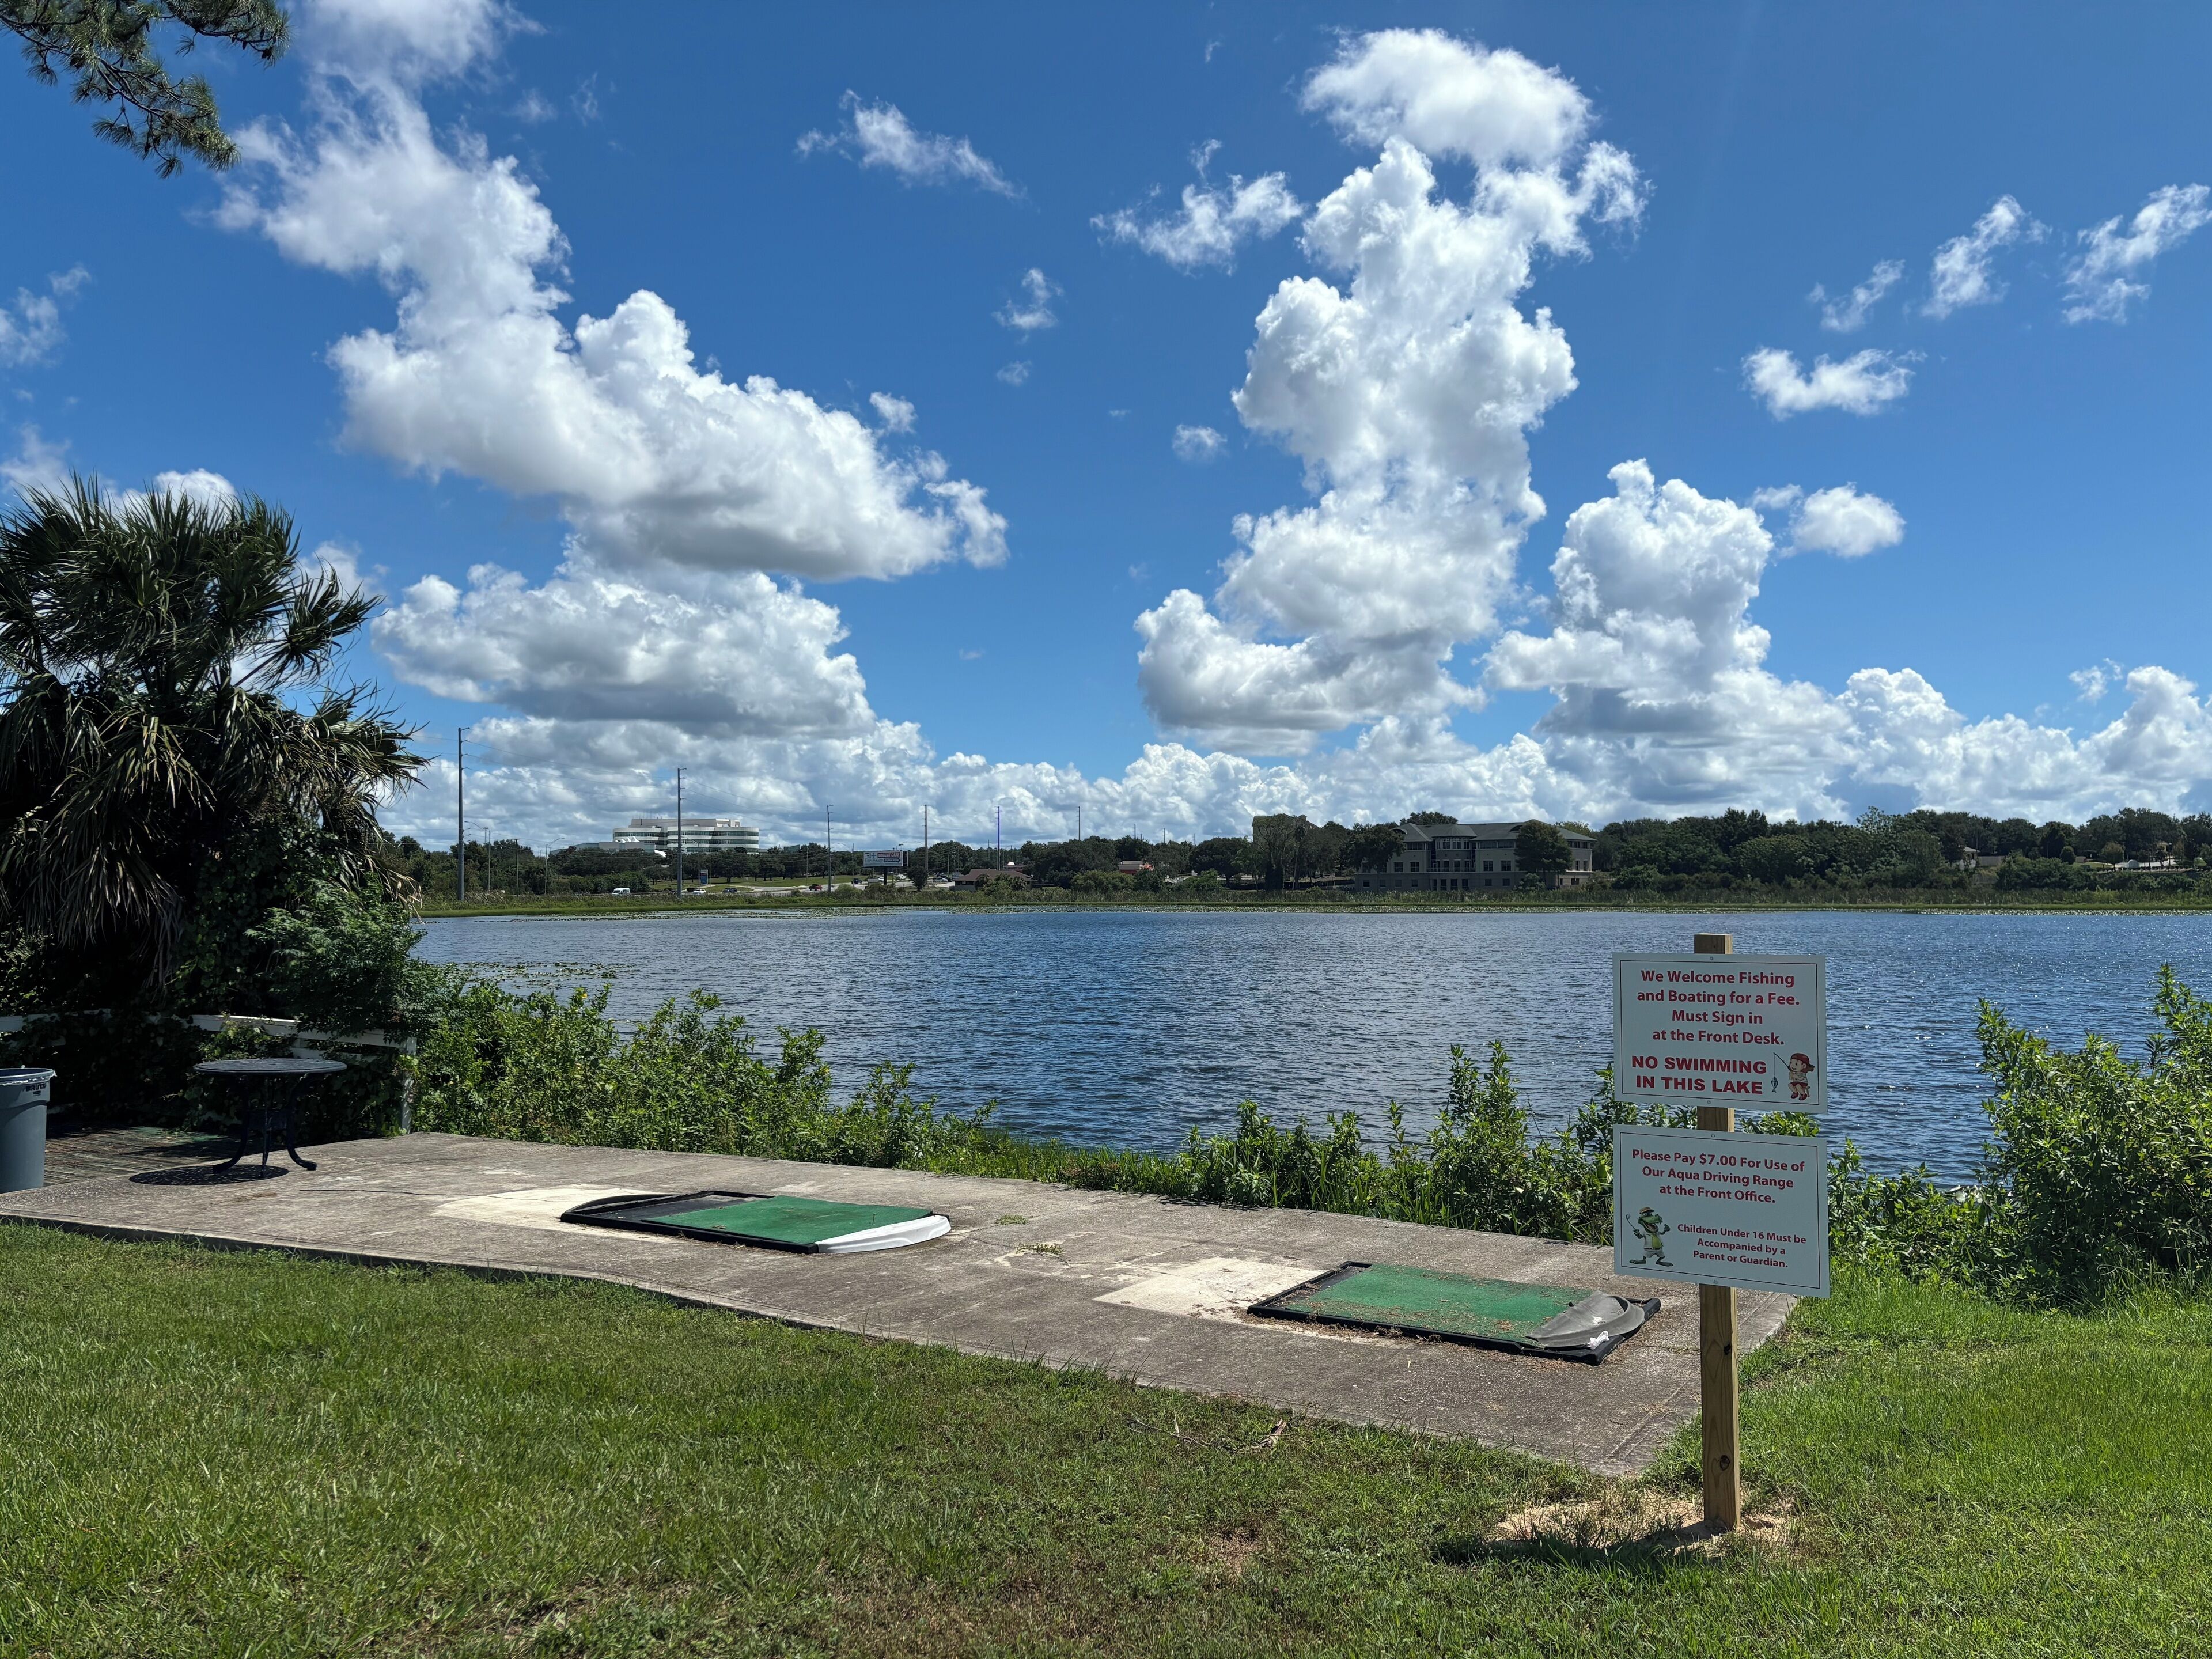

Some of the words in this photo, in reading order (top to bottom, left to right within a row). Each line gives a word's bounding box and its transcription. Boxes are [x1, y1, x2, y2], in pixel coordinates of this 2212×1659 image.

[1641, 970, 1663, 982] We
[1667, 971, 1734, 983] Welcome
[1740, 972, 1794, 988] Fishing
[1637, 990, 1664, 1001] and
[1669, 990, 1725, 1006] Boating
[1729, 991, 1751, 1003] for
[1755, 995, 1763, 1004] a
[1768, 993, 1799, 1005] Fee.
[1672, 1010, 1708, 1022] Must
[1712, 1011, 1744, 1026] Sign
[1749, 1012, 1762, 1024] in
[1653, 1030, 1666, 1040] at
[1670, 1029, 1694, 1041] the
[1699, 1031, 1738, 1043] Front
[1743, 1032, 1784, 1044] Desk.
[1632, 1056, 1658, 1069] NO
[1664, 1057, 1766, 1074] SWIMMING
[1637, 1075, 1654, 1088] IN
[1661, 1077, 1705, 1091] THIS
[1712, 1080, 1762, 1094] LAKE
[1633, 1149, 1671, 1161] Please
[1674, 1153, 1696, 1165] Pay
[1699, 1153, 1736, 1166] $7.00
[1741, 1157, 1761, 1168] For
[1764, 1159, 1787, 1170] Use
[1791, 1161, 1805, 1172] of
[1642, 1166, 1665, 1177] Our
[1668, 1168, 1699, 1181] Aqua
[1703, 1171, 1749, 1187] Driving
[1753, 1175, 1793, 1190] Range
[1660, 1185, 1671, 1194] at
[1675, 1185, 1694, 1196] the
[1698, 1187, 1731, 1199] Front
[1734, 1190, 1775, 1203] Office.
[1678, 1224, 1717, 1234] Children
[1721, 1228, 1750, 1238] Under
[1767, 1233, 1791, 1242] Must
[1794, 1234, 1806, 1244] be
[1697, 1238, 1763, 1252] Accompanied
[1766, 1245, 1778, 1255] by
[1694, 1251, 1725, 1261] Parent
[1740, 1255, 1787, 1267] Guardian.
